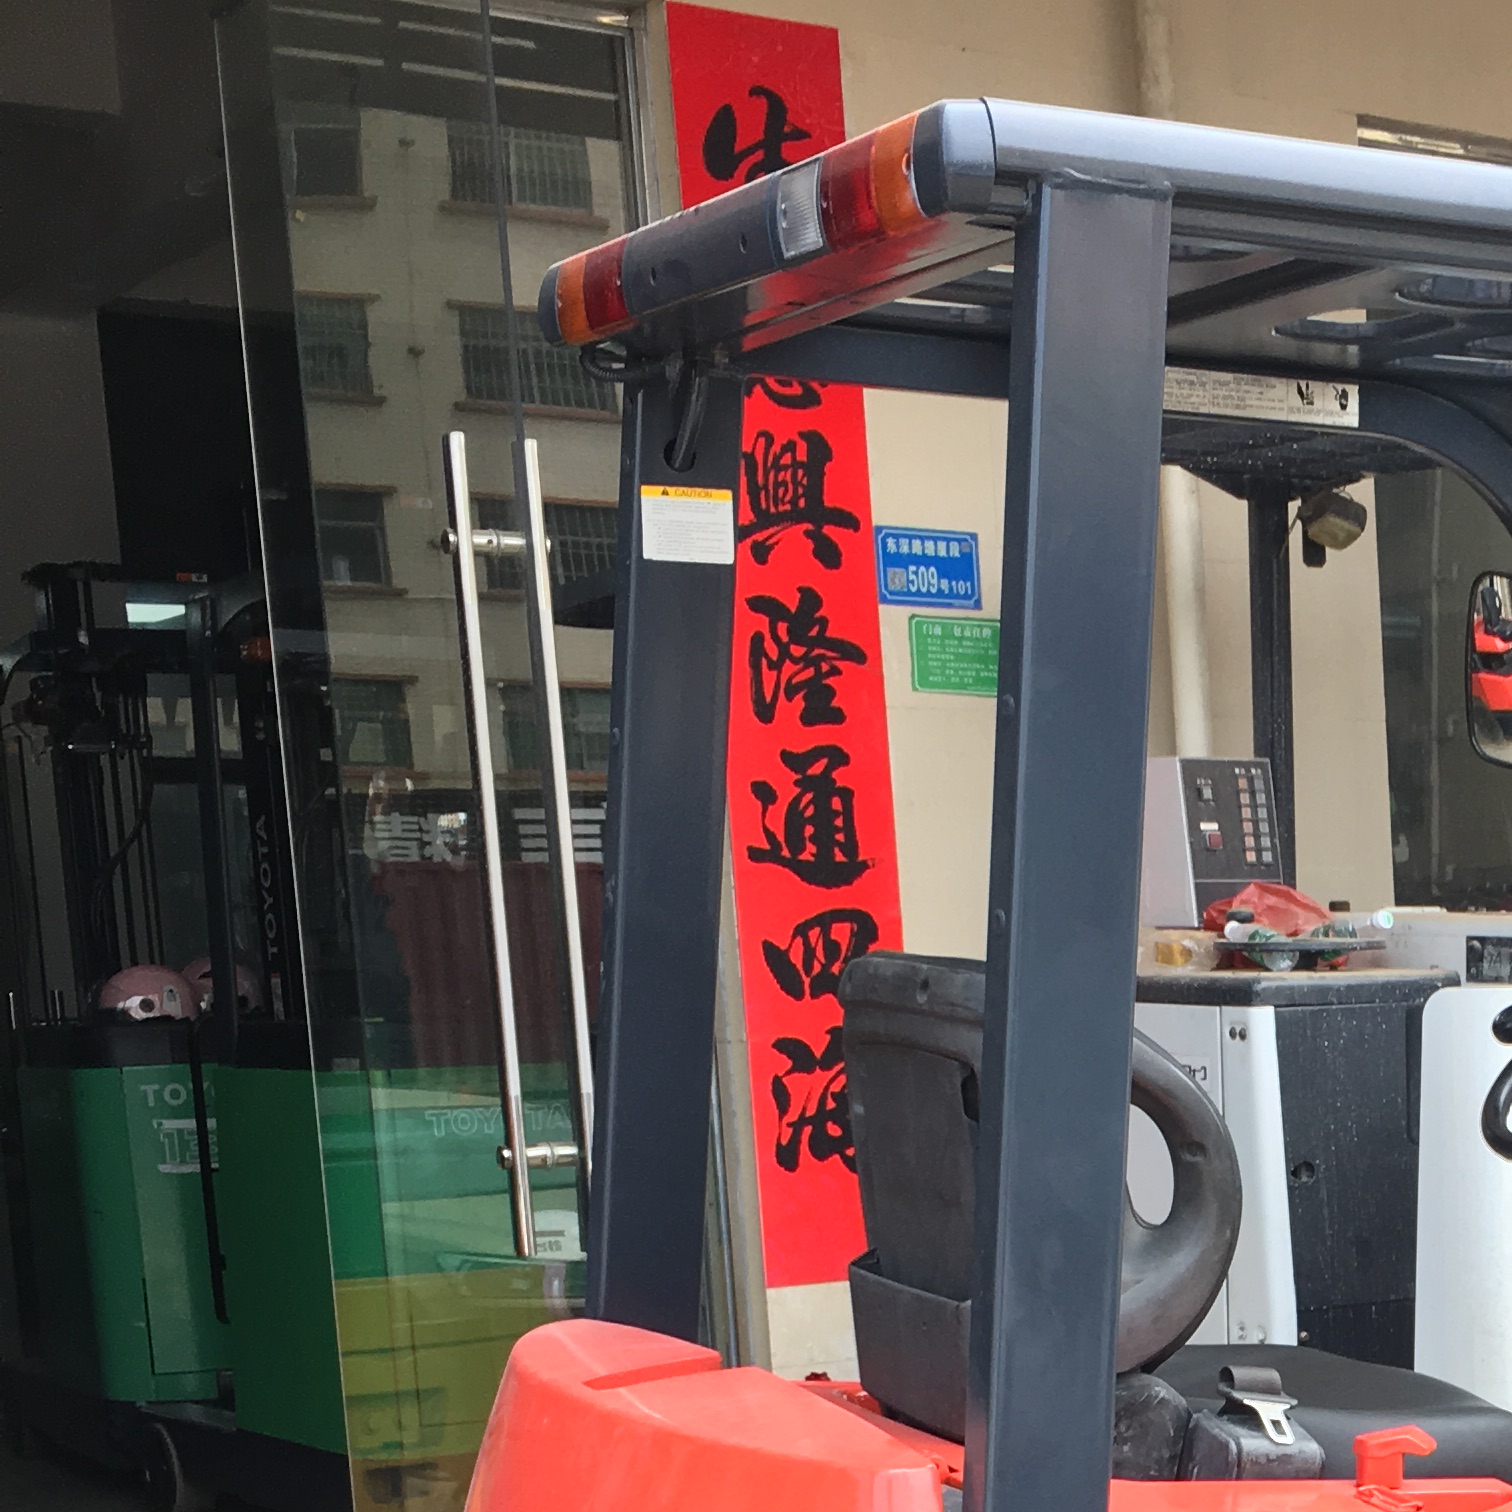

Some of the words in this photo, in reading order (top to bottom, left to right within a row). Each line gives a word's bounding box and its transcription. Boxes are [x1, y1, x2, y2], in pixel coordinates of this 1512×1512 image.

[674, 488, 713, 499] CAUTION
[256, 815, 278, 961] TOYOTA
[425, 1103, 572, 1137] TOYTA
